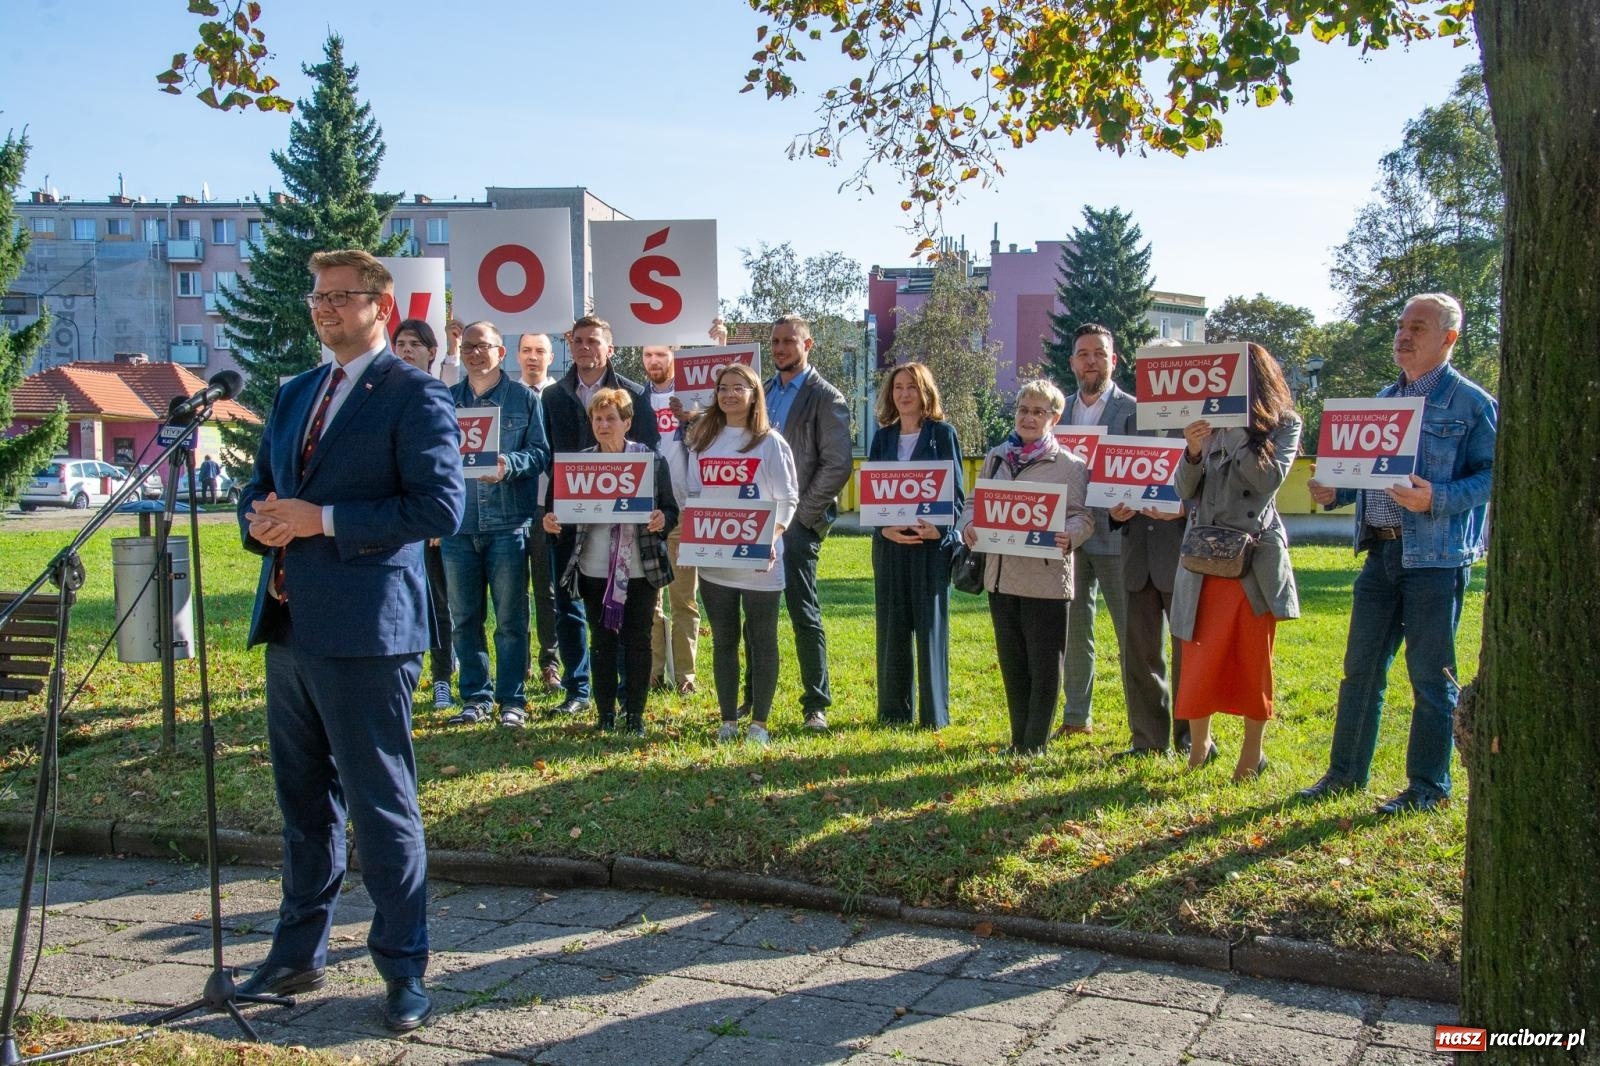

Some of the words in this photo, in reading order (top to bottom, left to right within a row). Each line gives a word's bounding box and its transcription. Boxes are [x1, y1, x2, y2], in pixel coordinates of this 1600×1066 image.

[478, 244, 545, 313] O
[629, 226, 682, 324] Ś
[1160, 360, 1183, 368] SEJMU
[1184, 359, 1212, 367] MICHAŁ
[1148, 356, 1227, 395] WOŚ
[1210, 398, 1219, 412] 3
[1331, 414, 1342, 422] DO
[1331, 412, 1400, 451] WOŚ
[1105, 447, 1116, 455] DO
[1116, 448, 1136, 456] SEJMU
[468, 454, 476, 465] 3
[1104, 450, 1169, 481] WOŚ
[1379, 457, 1389, 471] 3
[703, 460, 748, 482] WOŚ
[566, 463, 636, 494] WOŚ
[870, 471, 937, 499] WOŚ
[747, 485, 755, 497] 3
[1149, 486, 1159, 498] 3
[620, 499, 629, 510] 3
[922, 503, 931, 513] 3
[984, 495, 1048, 527] WOŚ
[693, 511, 758, 541] WOŚ
[1032, 532, 1041, 543] 3
[740, 545, 749, 556] 3
